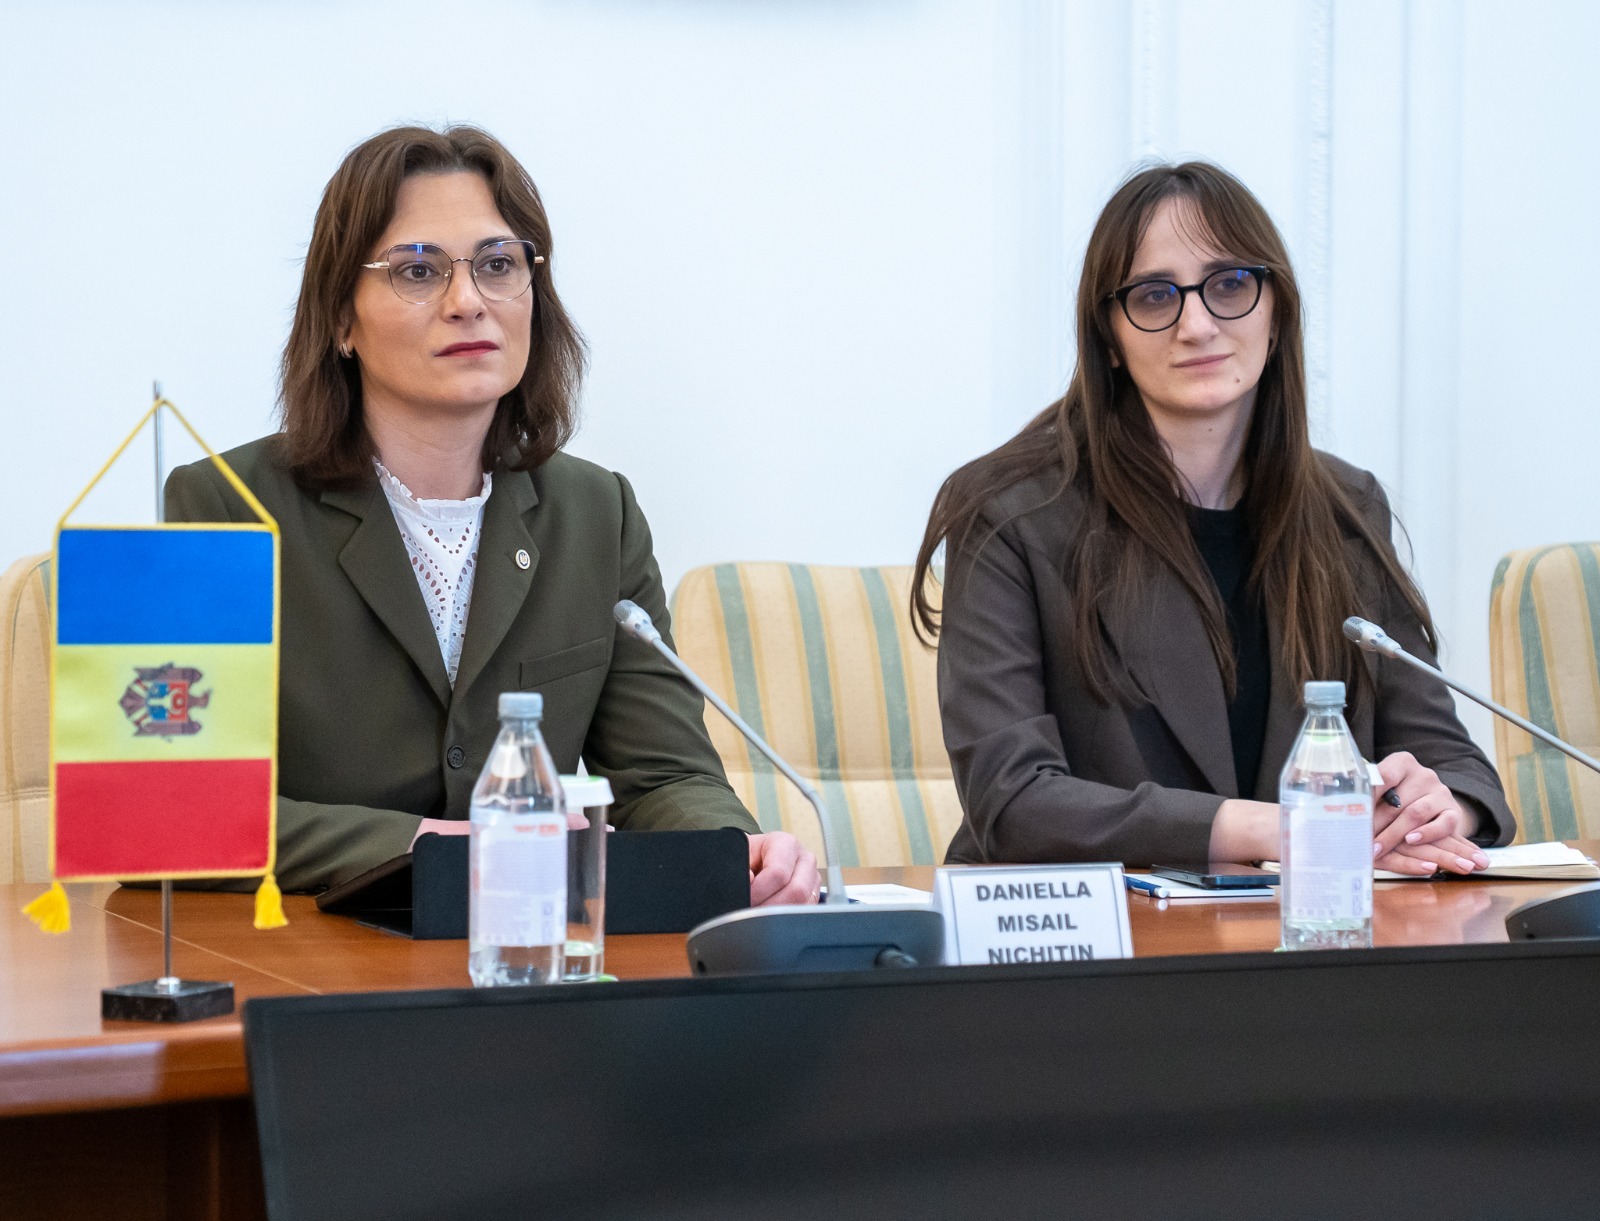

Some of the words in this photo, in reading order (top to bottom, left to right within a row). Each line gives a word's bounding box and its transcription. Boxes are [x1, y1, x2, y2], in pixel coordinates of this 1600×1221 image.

[976, 881, 1092, 901] DANIELLA
[998, 913, 1078, 932] MISAIL
[987, 944, 1094, 964] NICHITIN
